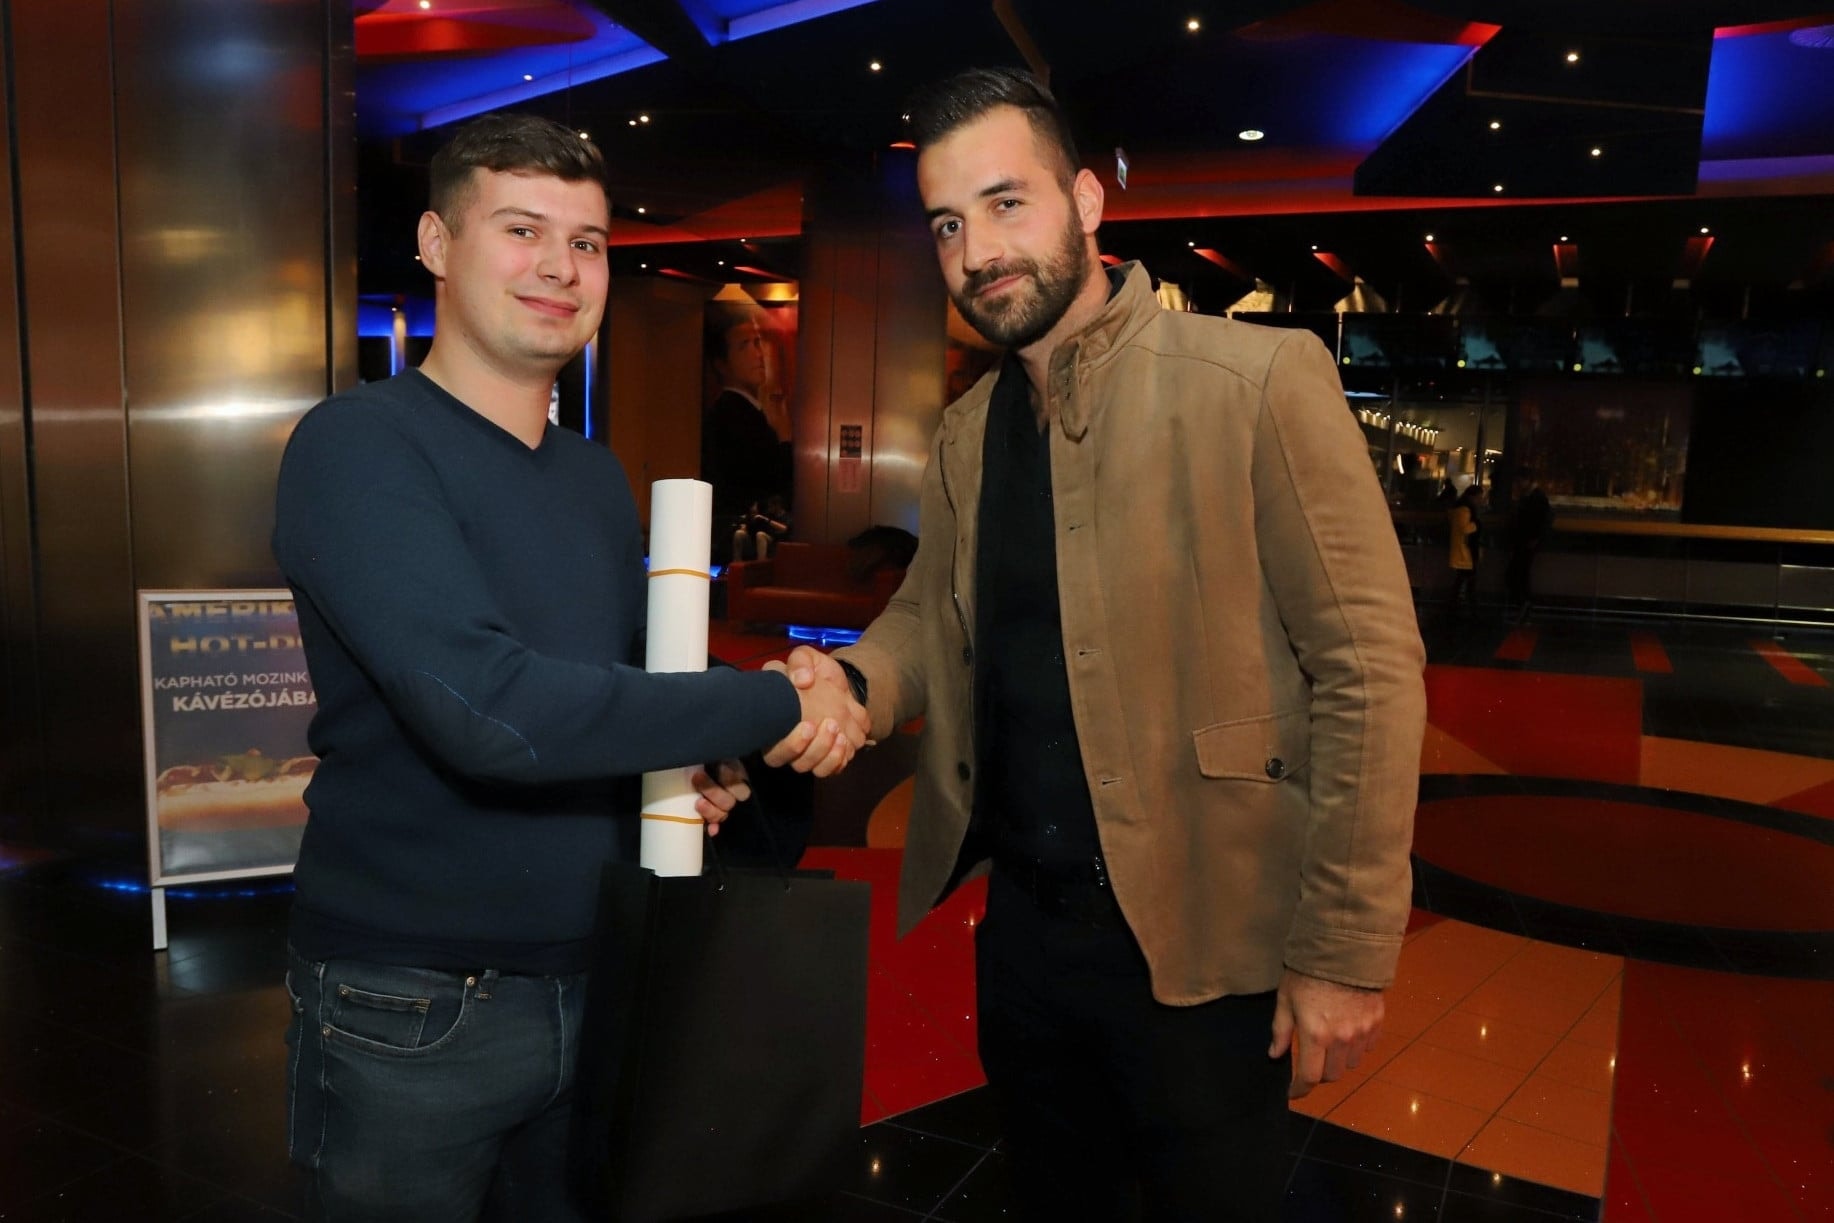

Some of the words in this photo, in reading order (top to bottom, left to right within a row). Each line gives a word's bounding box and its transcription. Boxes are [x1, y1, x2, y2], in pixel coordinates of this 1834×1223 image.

[170, 635, 303, 653] HOT-D
[154, 673, 238, 690] KAPHATÓ
[243, 671, 308, 686] MOZINK
